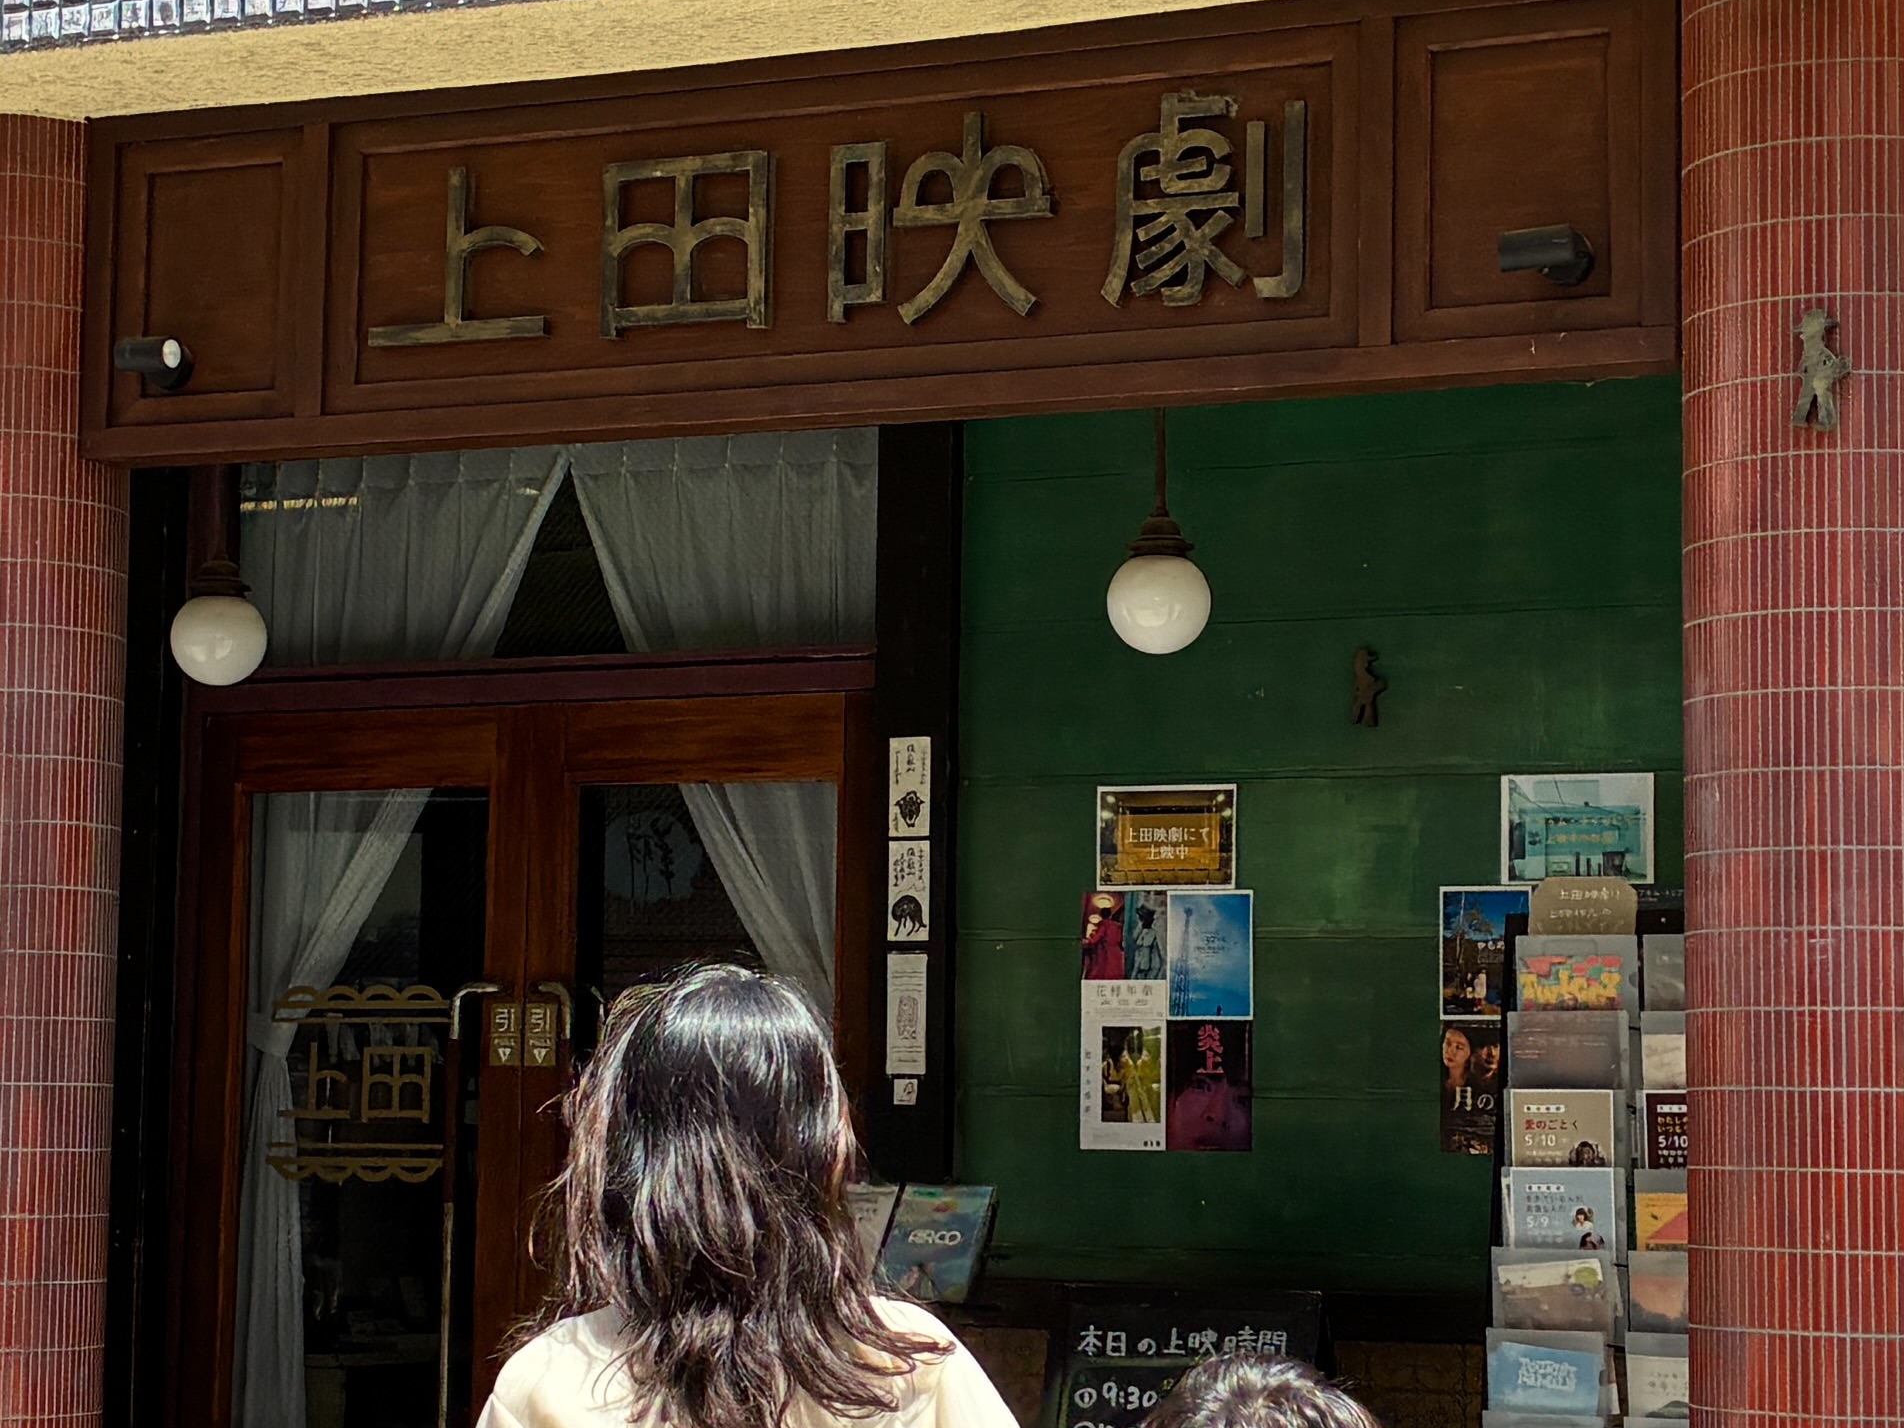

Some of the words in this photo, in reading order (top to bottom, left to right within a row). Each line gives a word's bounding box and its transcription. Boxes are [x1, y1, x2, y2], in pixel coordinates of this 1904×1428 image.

[368, 90, 1307, 348] 上田映劇
[1128, 827, 1211, 843] 上田映劇にて
[1148, 844, 1189, 860] 上映中
[1197, 1024, 1225, 1074] 炎上
[276, 1041, 432, 1124] 上田
[1658, 1135, 1689, 1148] 5/10
[1078, 1325, 1288, 1358] 本日の上映時間
